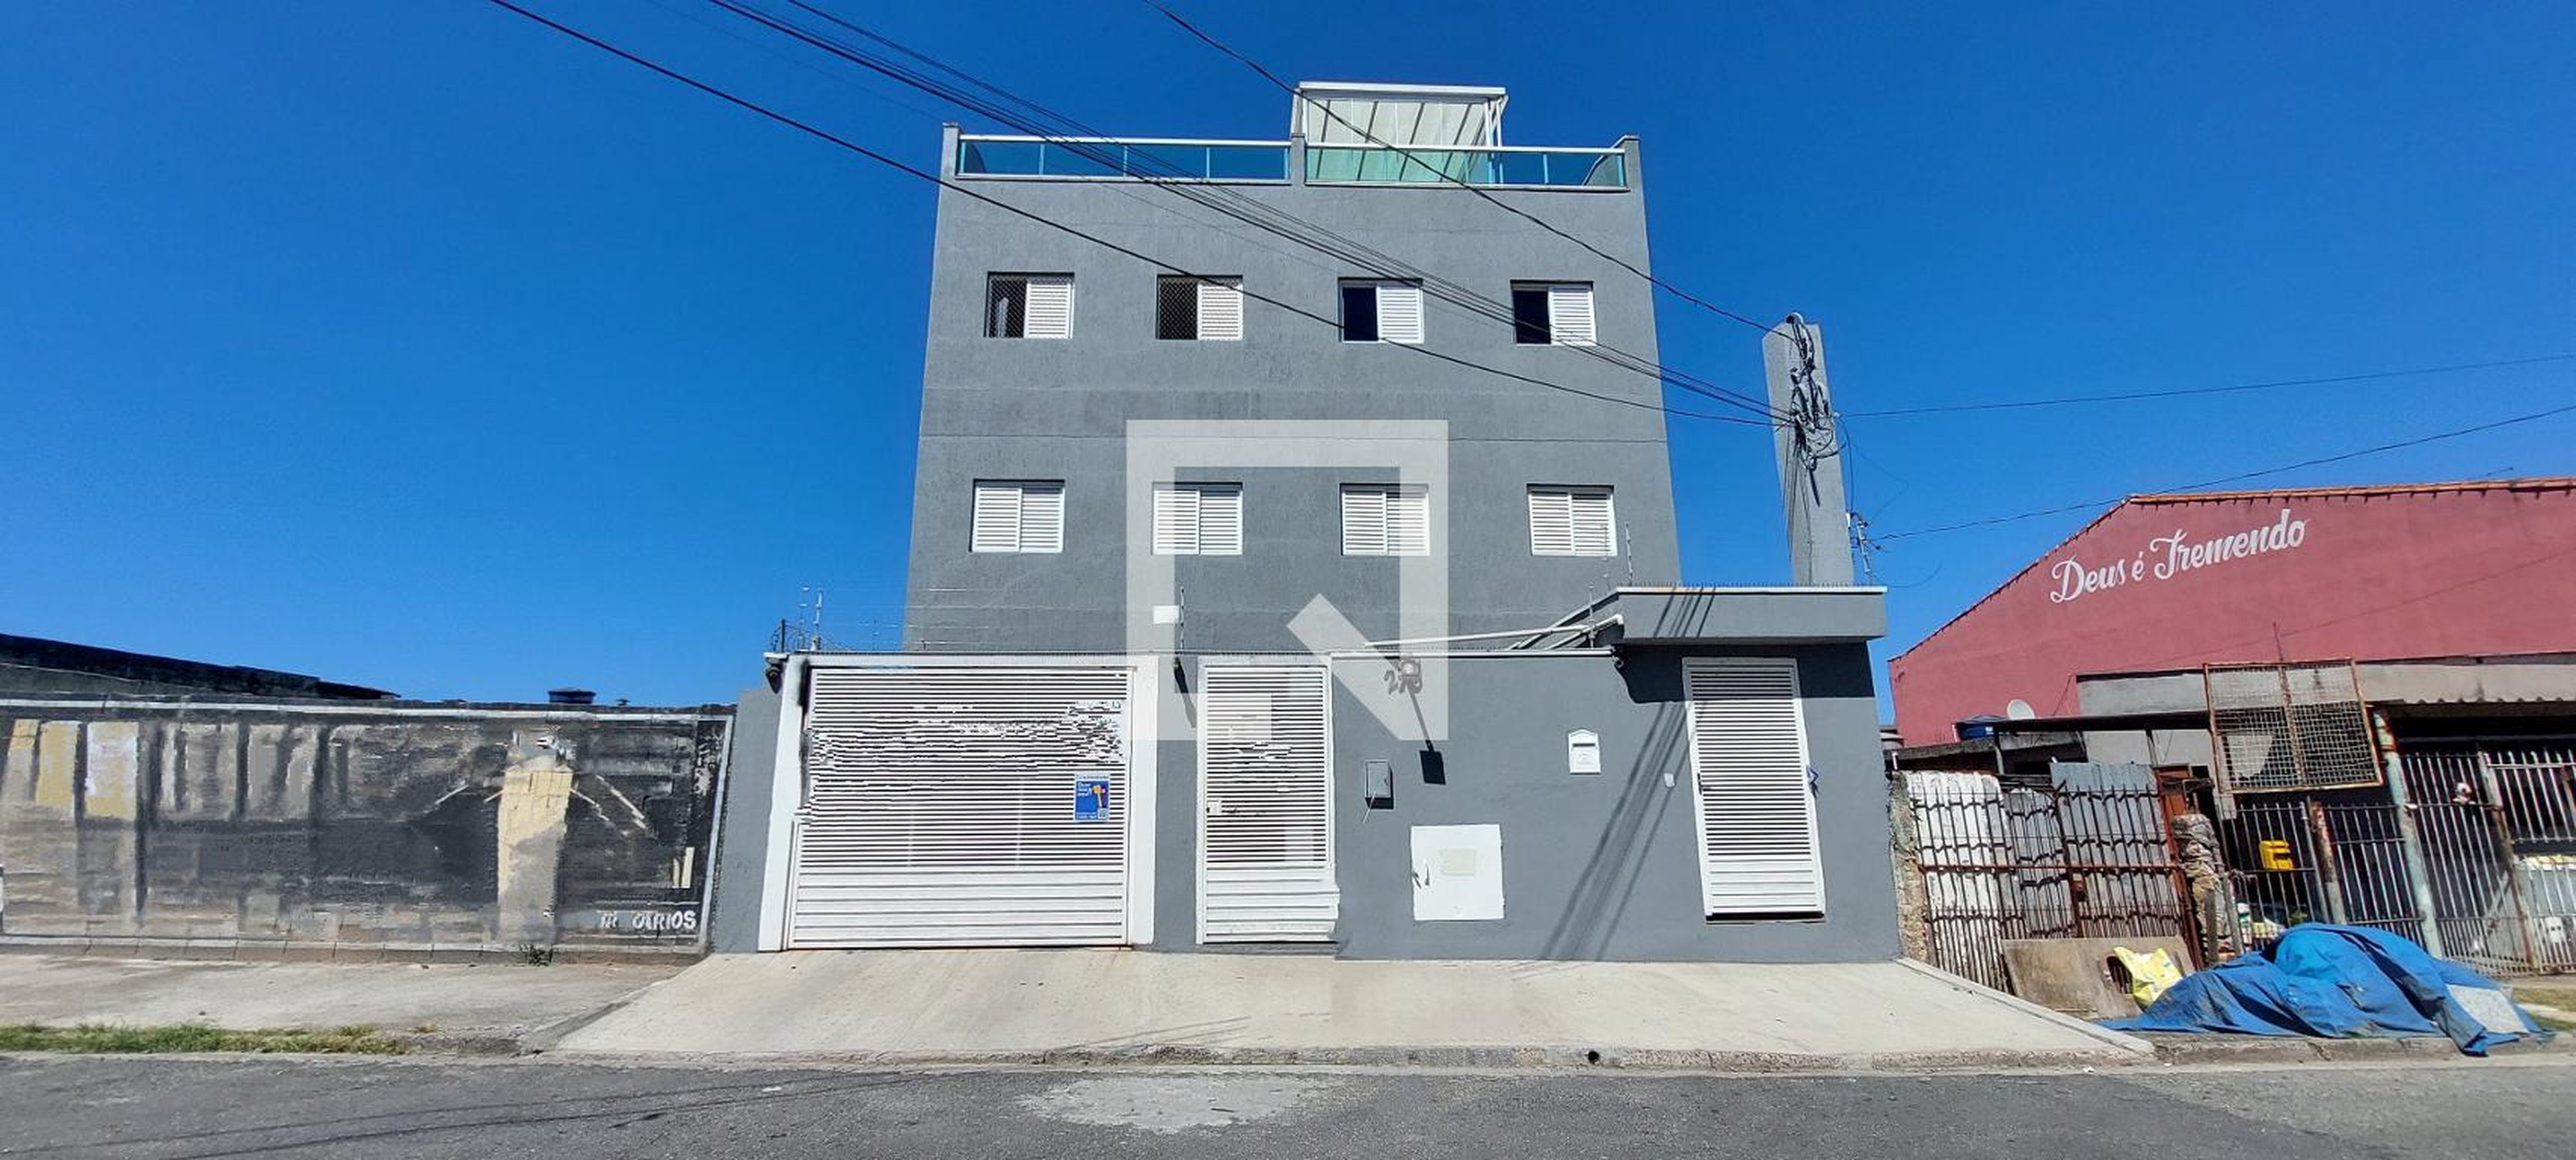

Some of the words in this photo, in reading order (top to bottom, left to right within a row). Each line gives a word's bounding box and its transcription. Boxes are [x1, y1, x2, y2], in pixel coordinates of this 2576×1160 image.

[2050, 553, 2126, 603] Deus
[2131, 551, 2146, 582] é
[2149, 509, 2311, 580] Tremendo
